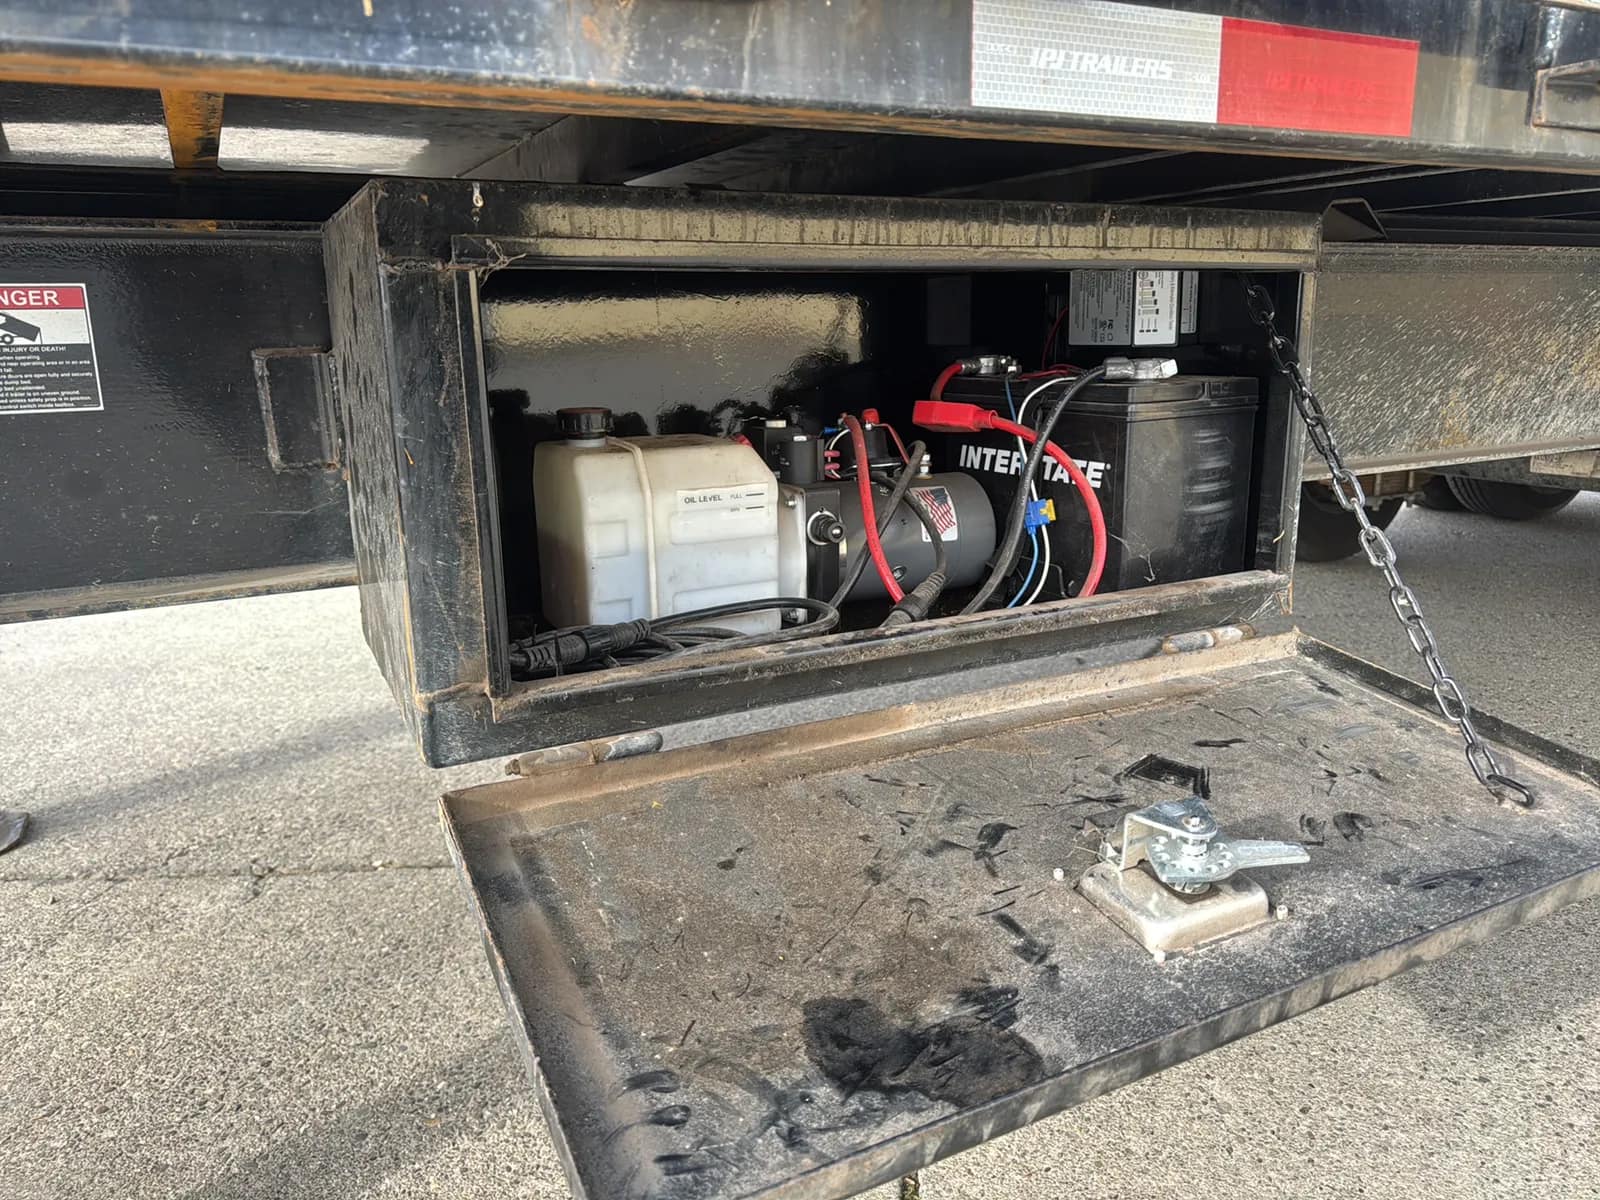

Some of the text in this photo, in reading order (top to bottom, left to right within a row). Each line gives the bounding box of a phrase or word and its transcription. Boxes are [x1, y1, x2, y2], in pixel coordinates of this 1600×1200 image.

[1069, 51, 1175, 81] TRAILERS
[959, 444, 1105, 489] INTERTAE
[684, 494, 723, 505] OIL LEVEL
